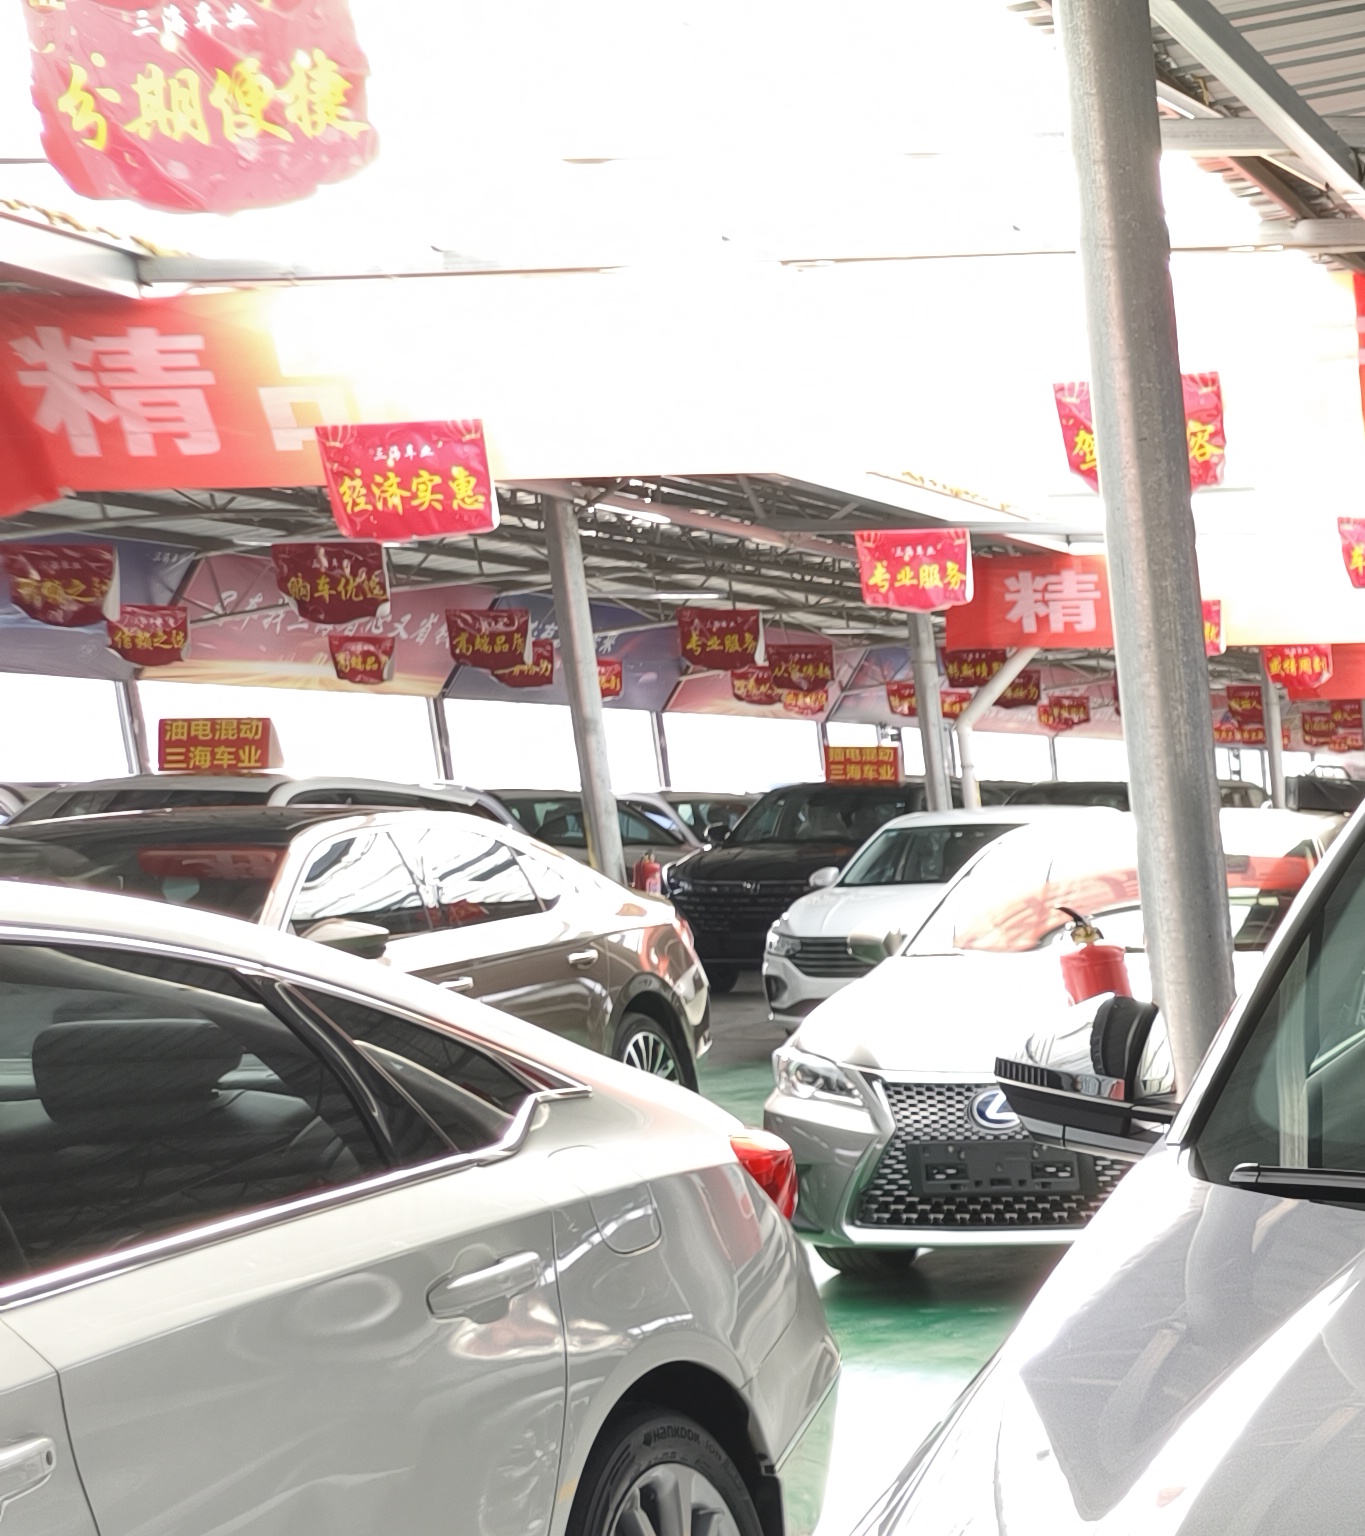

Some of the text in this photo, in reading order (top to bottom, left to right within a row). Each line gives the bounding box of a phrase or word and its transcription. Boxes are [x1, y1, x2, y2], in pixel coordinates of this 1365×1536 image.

[58, 48, 370, 150] 分期便捷
[339, 467, 486, 515] 经济实惠
[288, 574, 387, 603] 购车优选
[868, 561, 966, 593] 专业服务
[453, 632, 525, 655] 高端品质
[165, 719, 262, 741] 油电混动
[164, 745, 261, 769] 三海车业
[830, 764, 895, 780] 三海车业
